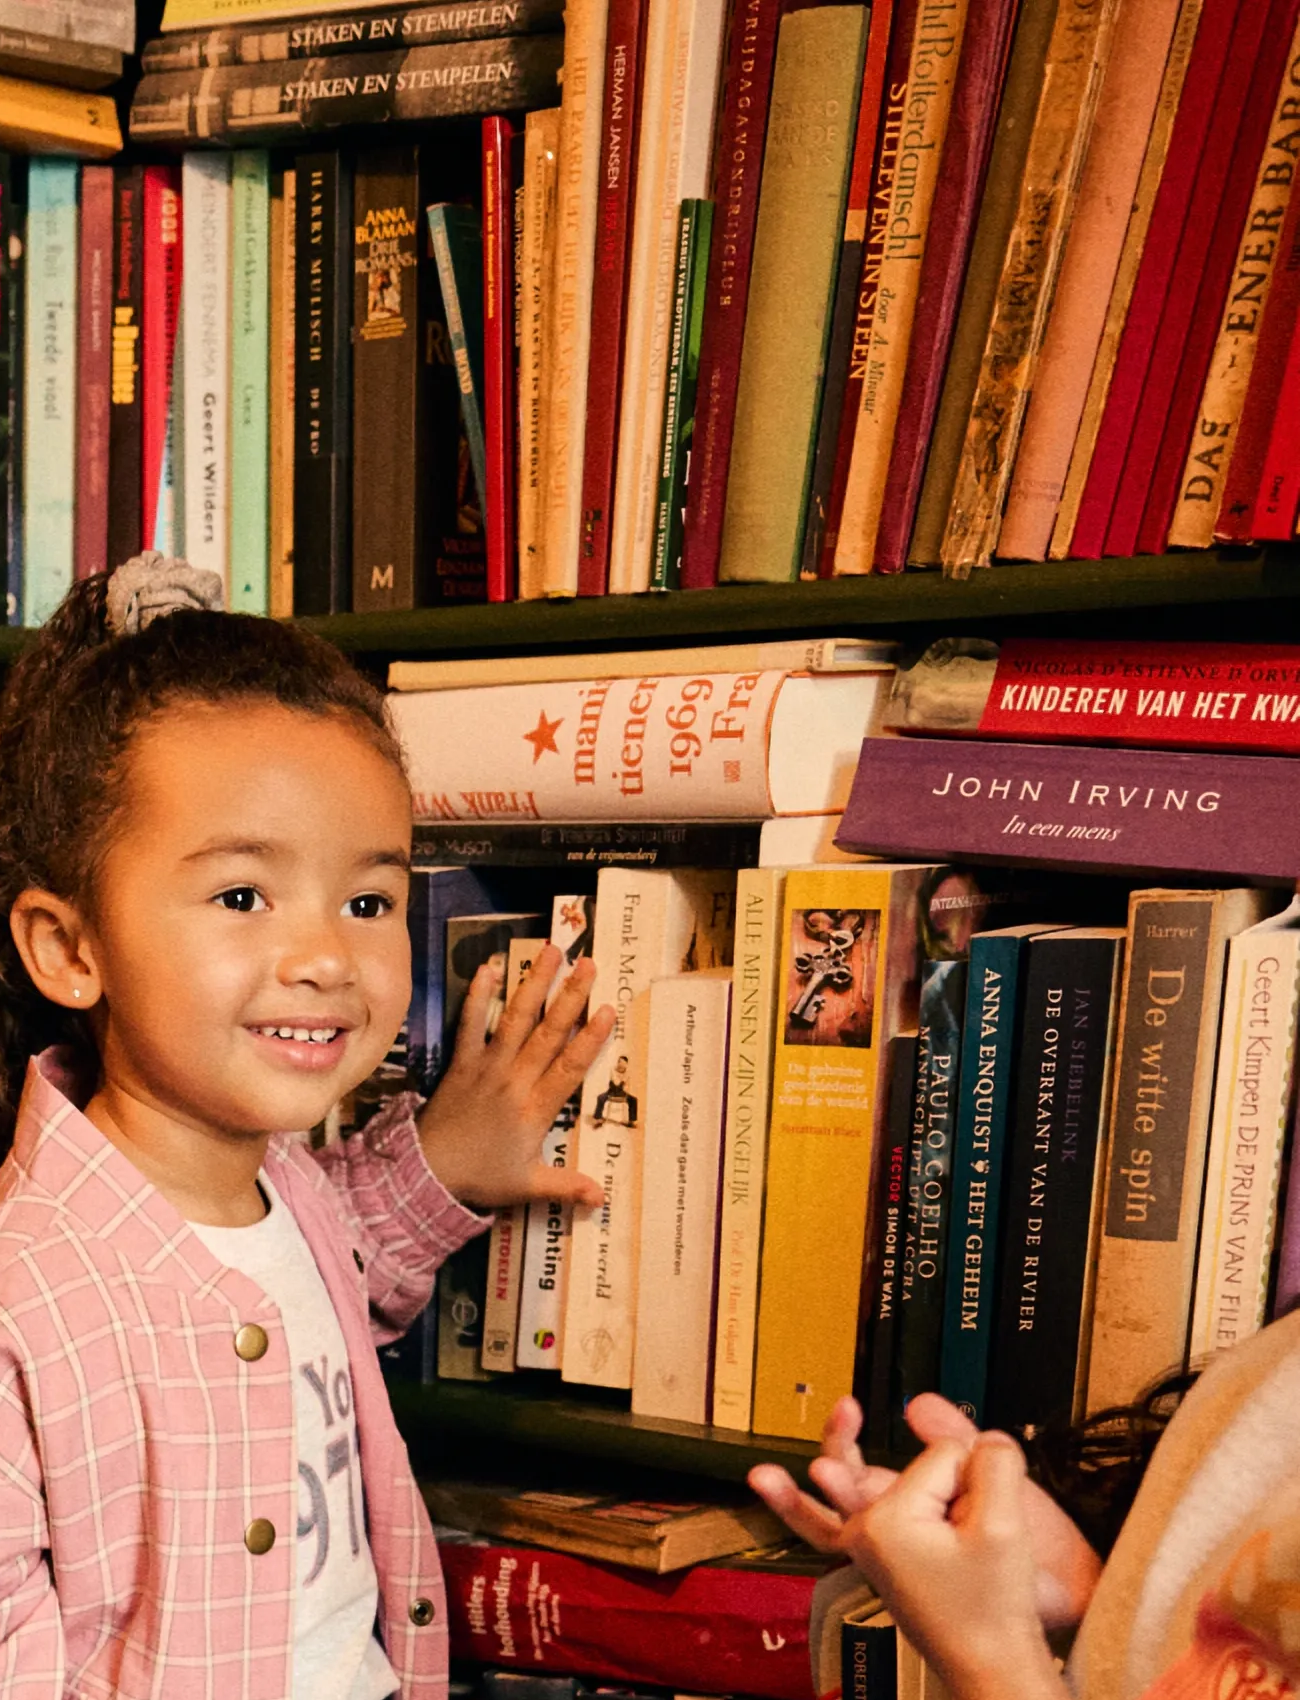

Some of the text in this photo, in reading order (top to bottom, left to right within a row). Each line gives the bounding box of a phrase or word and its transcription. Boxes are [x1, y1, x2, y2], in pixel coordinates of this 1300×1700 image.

[289, 2, 519, 49] STAKEN EN STEMPELEN
[280, 58, 514, 104] STAKEN EN STEMPELEN
[604, 45, 628, 188] HERMAN JANSEN
[893, 37, 953, 264] Rotterdamsch!
[309, 171, 322, 361] HARRY MULISCH
[355, 221, 416, 244] BLAMAN
[363, 206, 406, 226] ANNA
[847, 82, 909, 381] STILLEVEN IN STEEN
[200, 393, 218, 543] Geert Wilders
[1182, 416, 1231, 506] DAS
[668, 679, 714, 778] 1969
[1001, 684, 1242, 720] KINDEREN VAN HET
[933, 772, 1222, 812] JOHN IRVING
[1002, 815, 1122, 843] In een mens
[617, 892, 641, 946] Frank
[728, 892, 765, 1205] ALLE MENSEN ZIJN ONGELIJK
[1059, 988, 1091, 1163] JAN SIEBELINK
[1237, 955, 1280, 1118] Geert Kimpen
[670, 1003, 698, 1275] Arthur Japin Zoals dat gaat met wonderen
[1114, 960, 1186, 1225] De witte spin
[604, 1141, 622, 1169] De
[886, 1145, 903, 1202] VECTOR
[916, 1054, 951, 1279] PAULO COELHO
[958, 967, 1000, 1329] ANNA ENQUIST HET GEHEIM
[1017, 988, 1063, 1332] DE OVERKANT VAN DE RIVIER
[594, 1242, 614, 1299] wereld
[879, 1207, 899, 1319] SIMON DE WAAL
[469, 1576, 485, 1636] Hitlers
[496, 1556, 518, 1658] hofhouding
[853, 1641, 869, 1698] ROBERT
